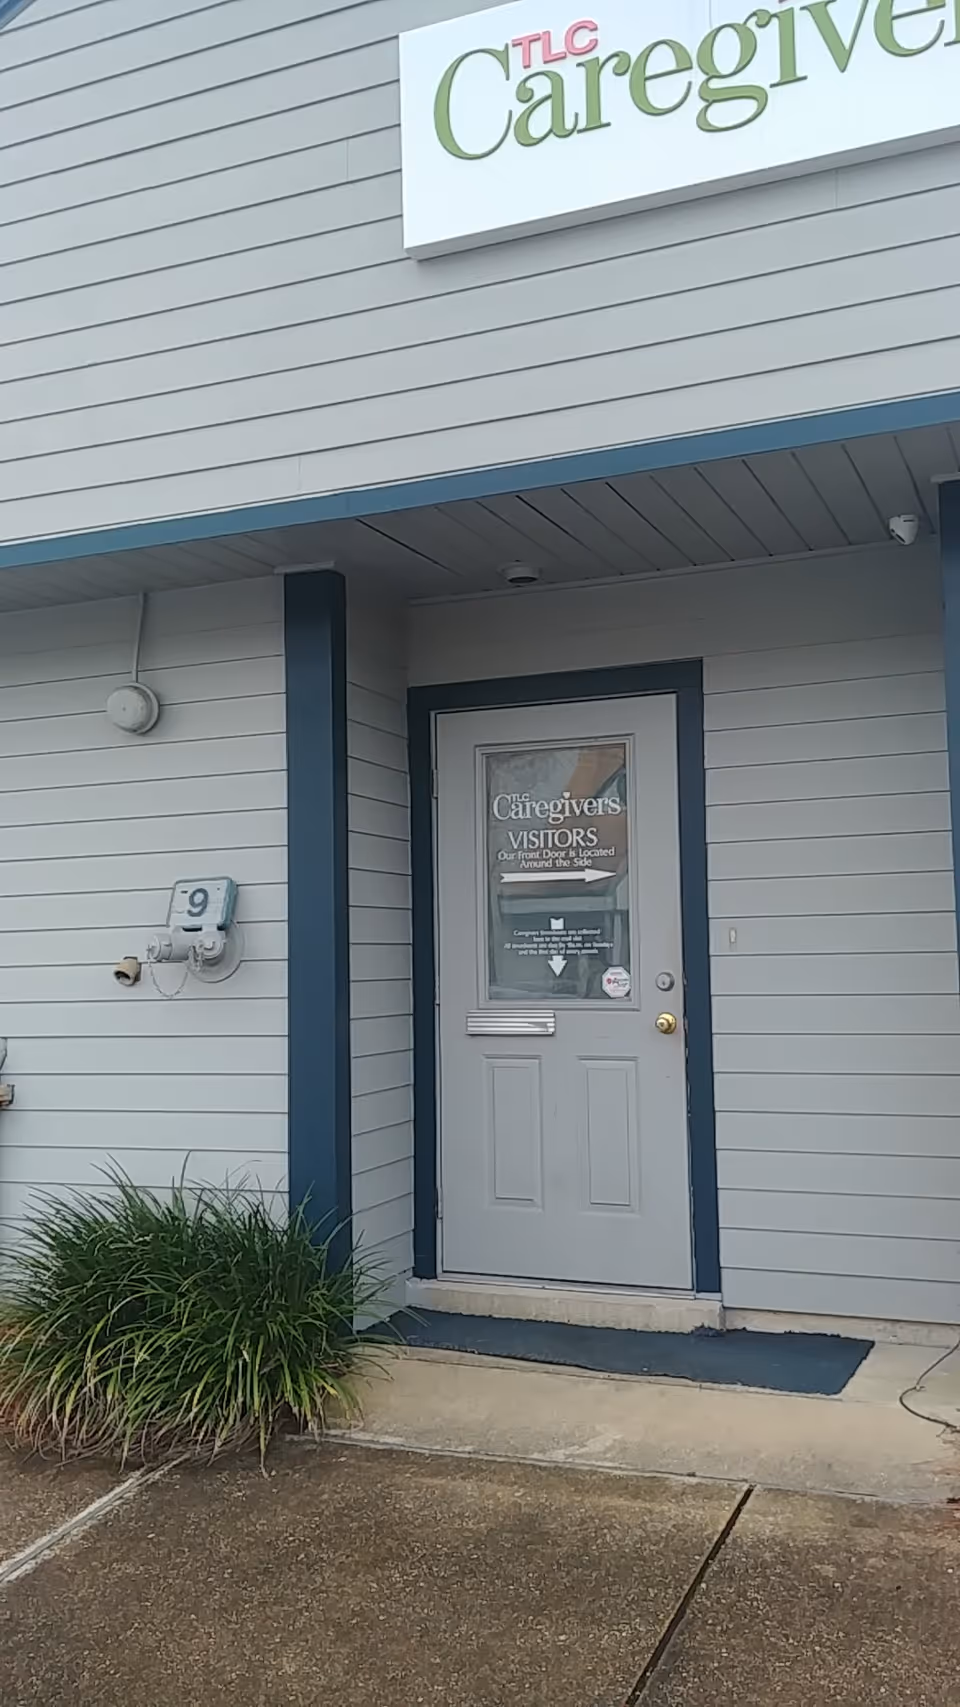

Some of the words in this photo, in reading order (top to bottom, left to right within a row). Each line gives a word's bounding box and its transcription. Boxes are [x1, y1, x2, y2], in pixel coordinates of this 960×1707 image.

[511, 19, 599, 69] TLC
[433, 0, 960, 160] Caregive
[492, 792, 622, 825] Caregivers
[497, 851, 516, 861] Our
[518, 850, 540, 860] Front
[543, 849, 567, 859] Door
[579, 846, 615, 857] Located
[508, 827, 599, 850] VISITORS
[520, 859, 553, 869] Around
[555, 858, 571, 868] the
[573, 857, 593, 867] Side
[186, 887, 209, 918] 9
